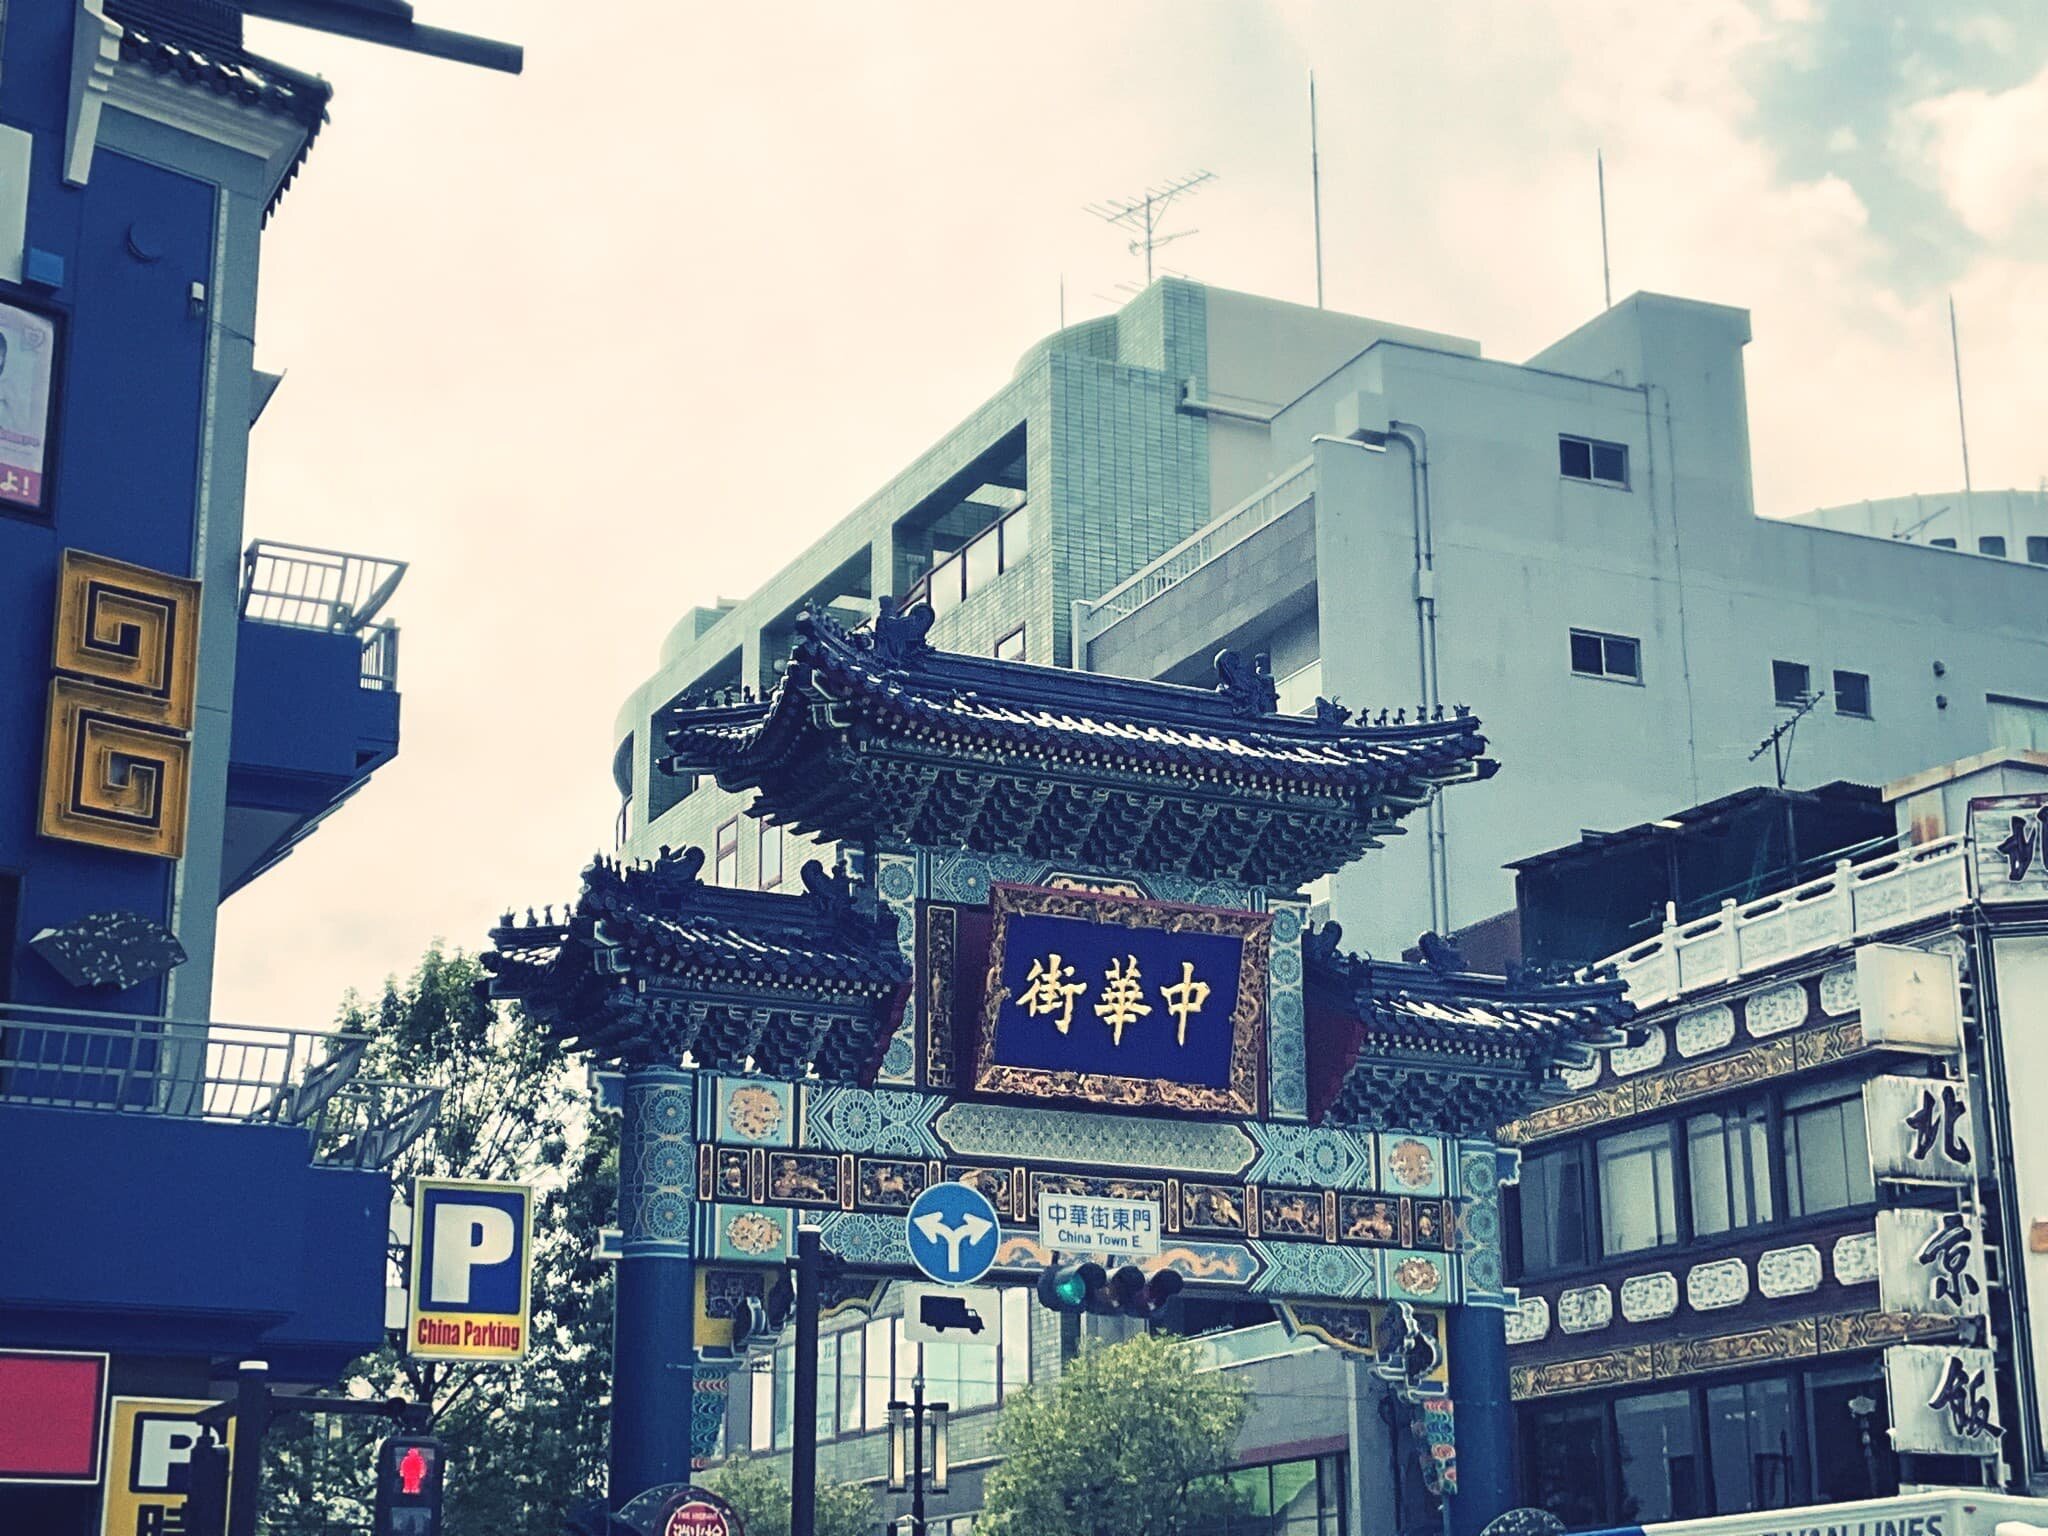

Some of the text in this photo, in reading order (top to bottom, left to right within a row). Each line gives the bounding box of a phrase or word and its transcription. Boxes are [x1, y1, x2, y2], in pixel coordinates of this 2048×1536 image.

[1048, 1203, 1152, 1232] 中華街東門
[430, 1203, 515, 1304] P
[1058, 1229, 1092, 1244] China
[1097, 1232, 1128, 1247] Town
[418, 1318, 520, 1351] China Parking
[138, 1419, 220, 1487] P
